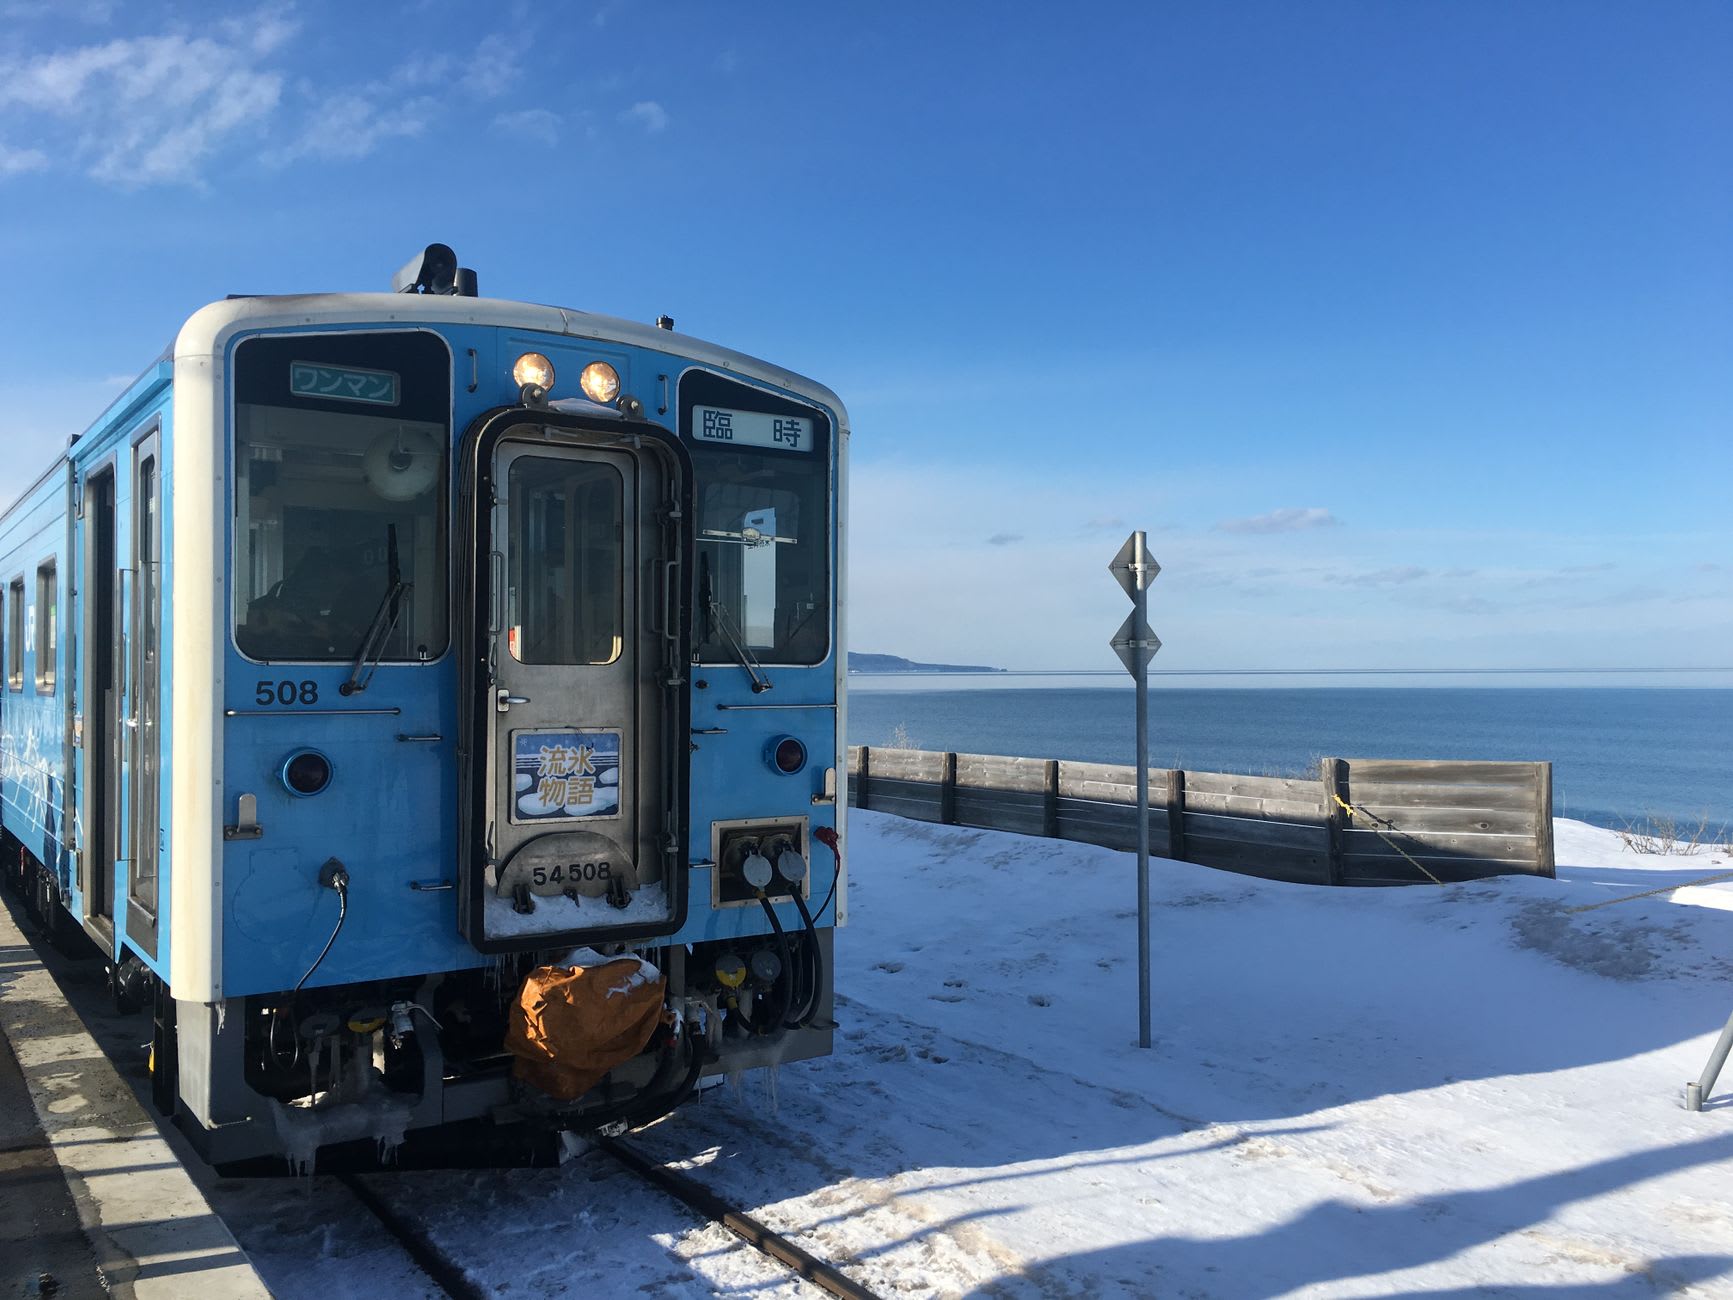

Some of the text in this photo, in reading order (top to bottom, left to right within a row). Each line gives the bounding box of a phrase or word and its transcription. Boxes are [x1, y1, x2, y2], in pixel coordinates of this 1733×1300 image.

[294, 367, 390, 398] ワンマン
[256, 680, 318, 705] 508
[539, 746, 595, 776] 流氷
[539, 776, 595, 806] 物語
